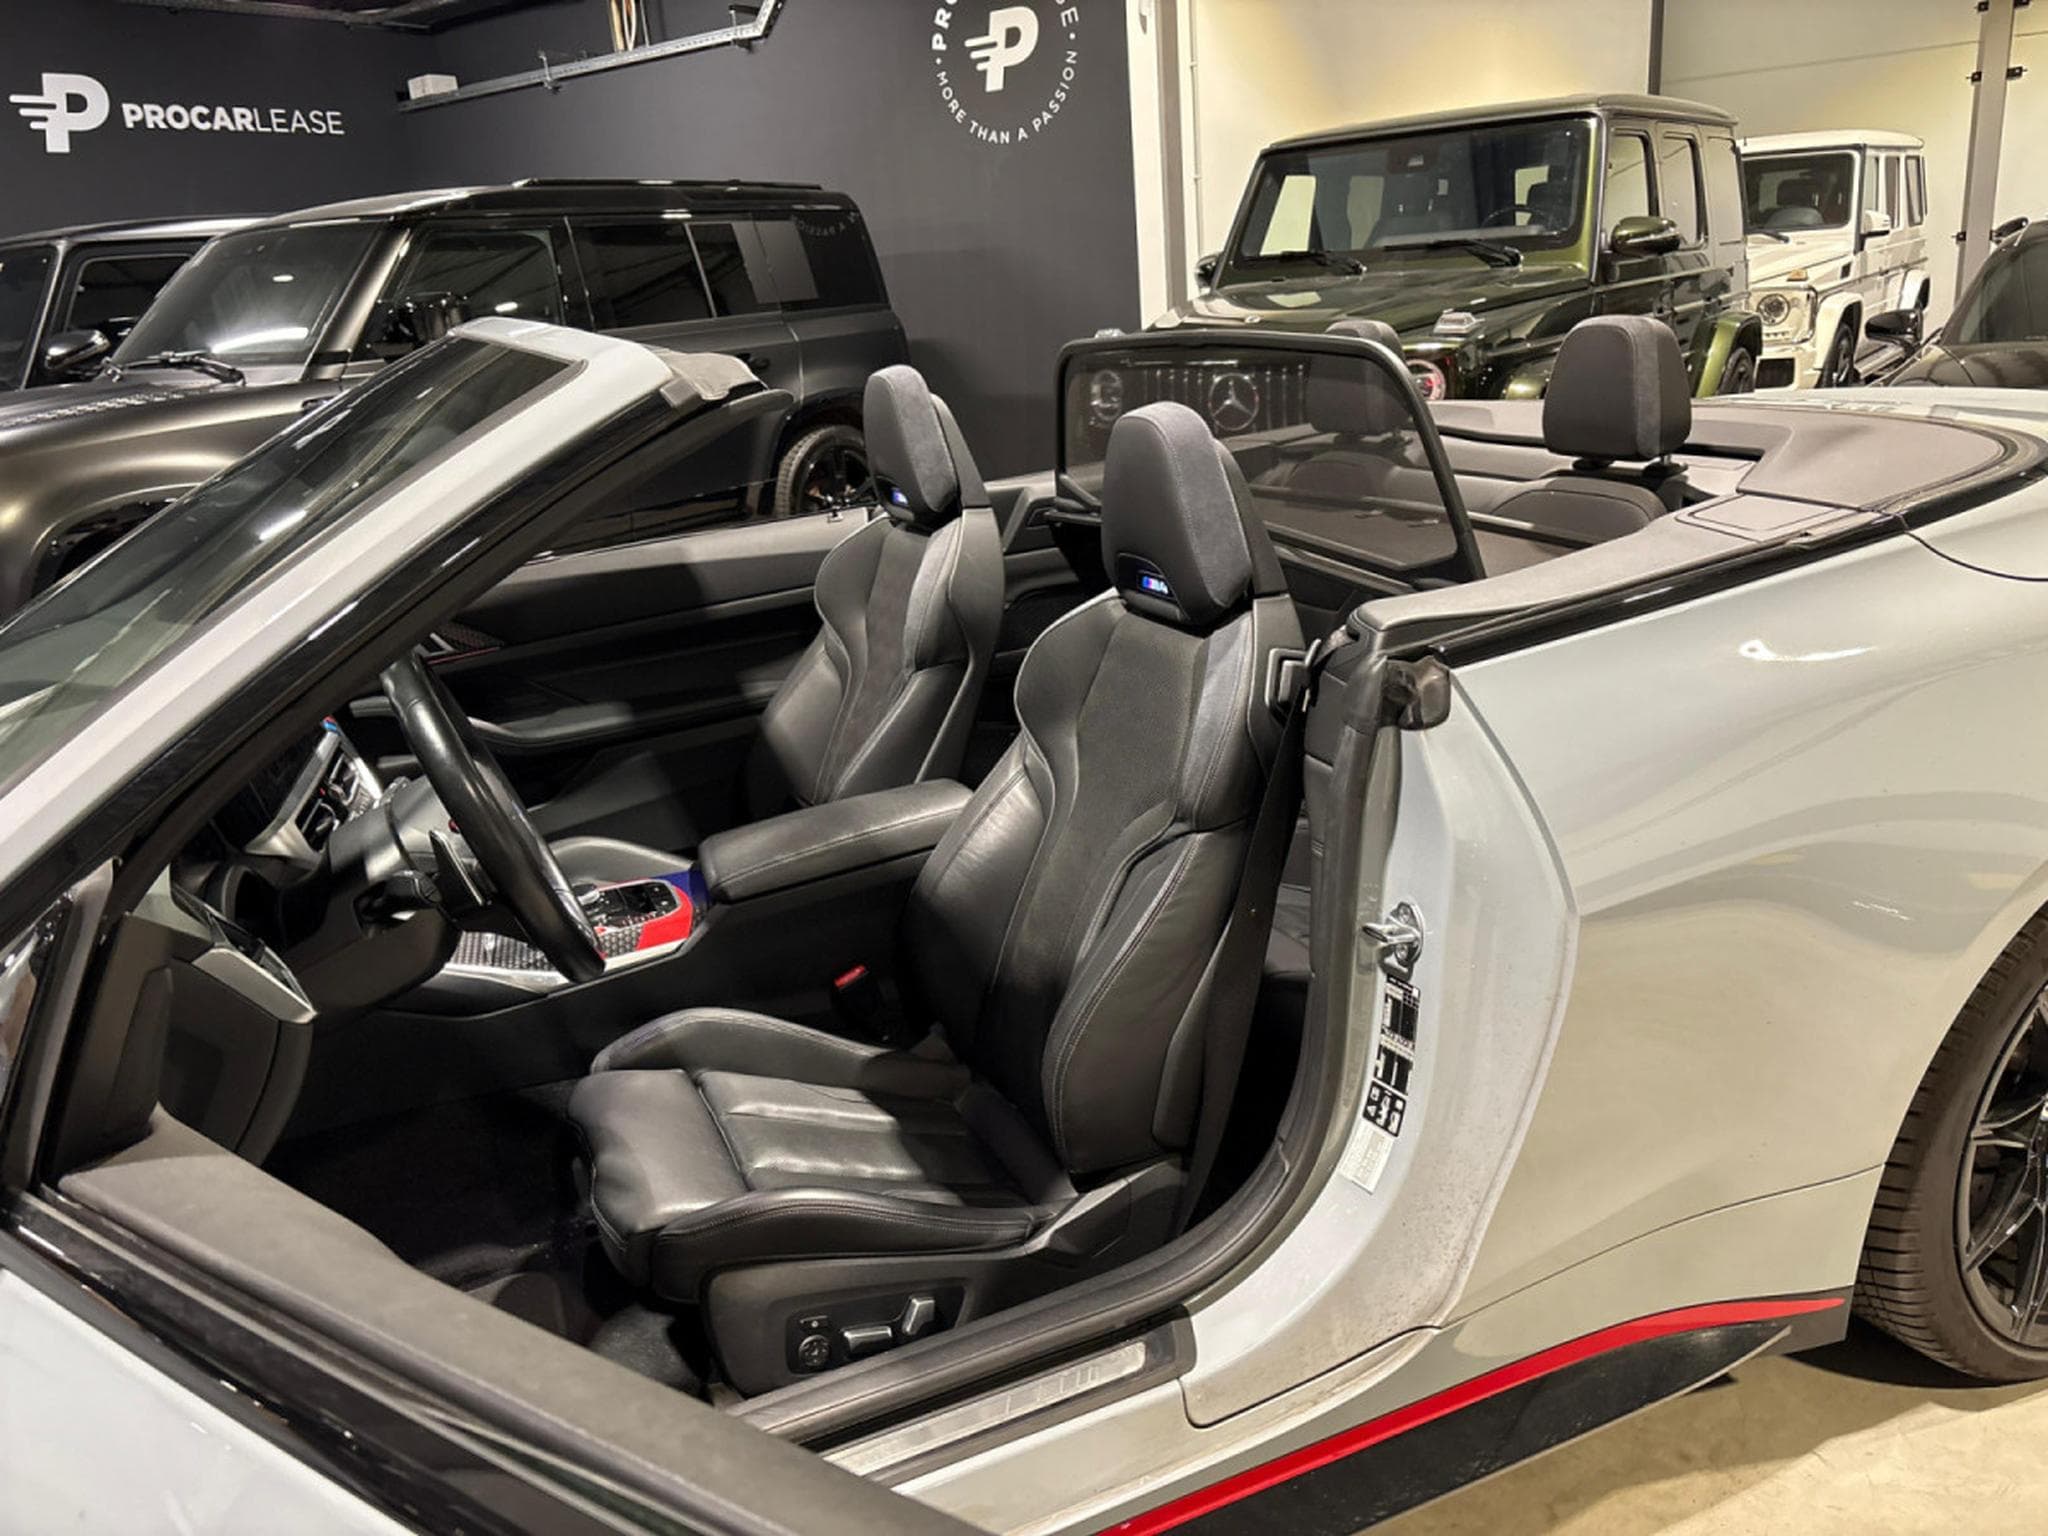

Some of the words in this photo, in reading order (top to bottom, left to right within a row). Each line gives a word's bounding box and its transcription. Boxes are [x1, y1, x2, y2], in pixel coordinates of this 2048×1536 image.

[932, 0, 957, 51] PR
[121, 102, 345, 135] PROCARLEASE
[937, 71, 966, 123] MORE
[969, 120, 1009, 143] THAN
[1018, 127, 1028, 141] A
[1032, 51, 1078, 132] PASSION
